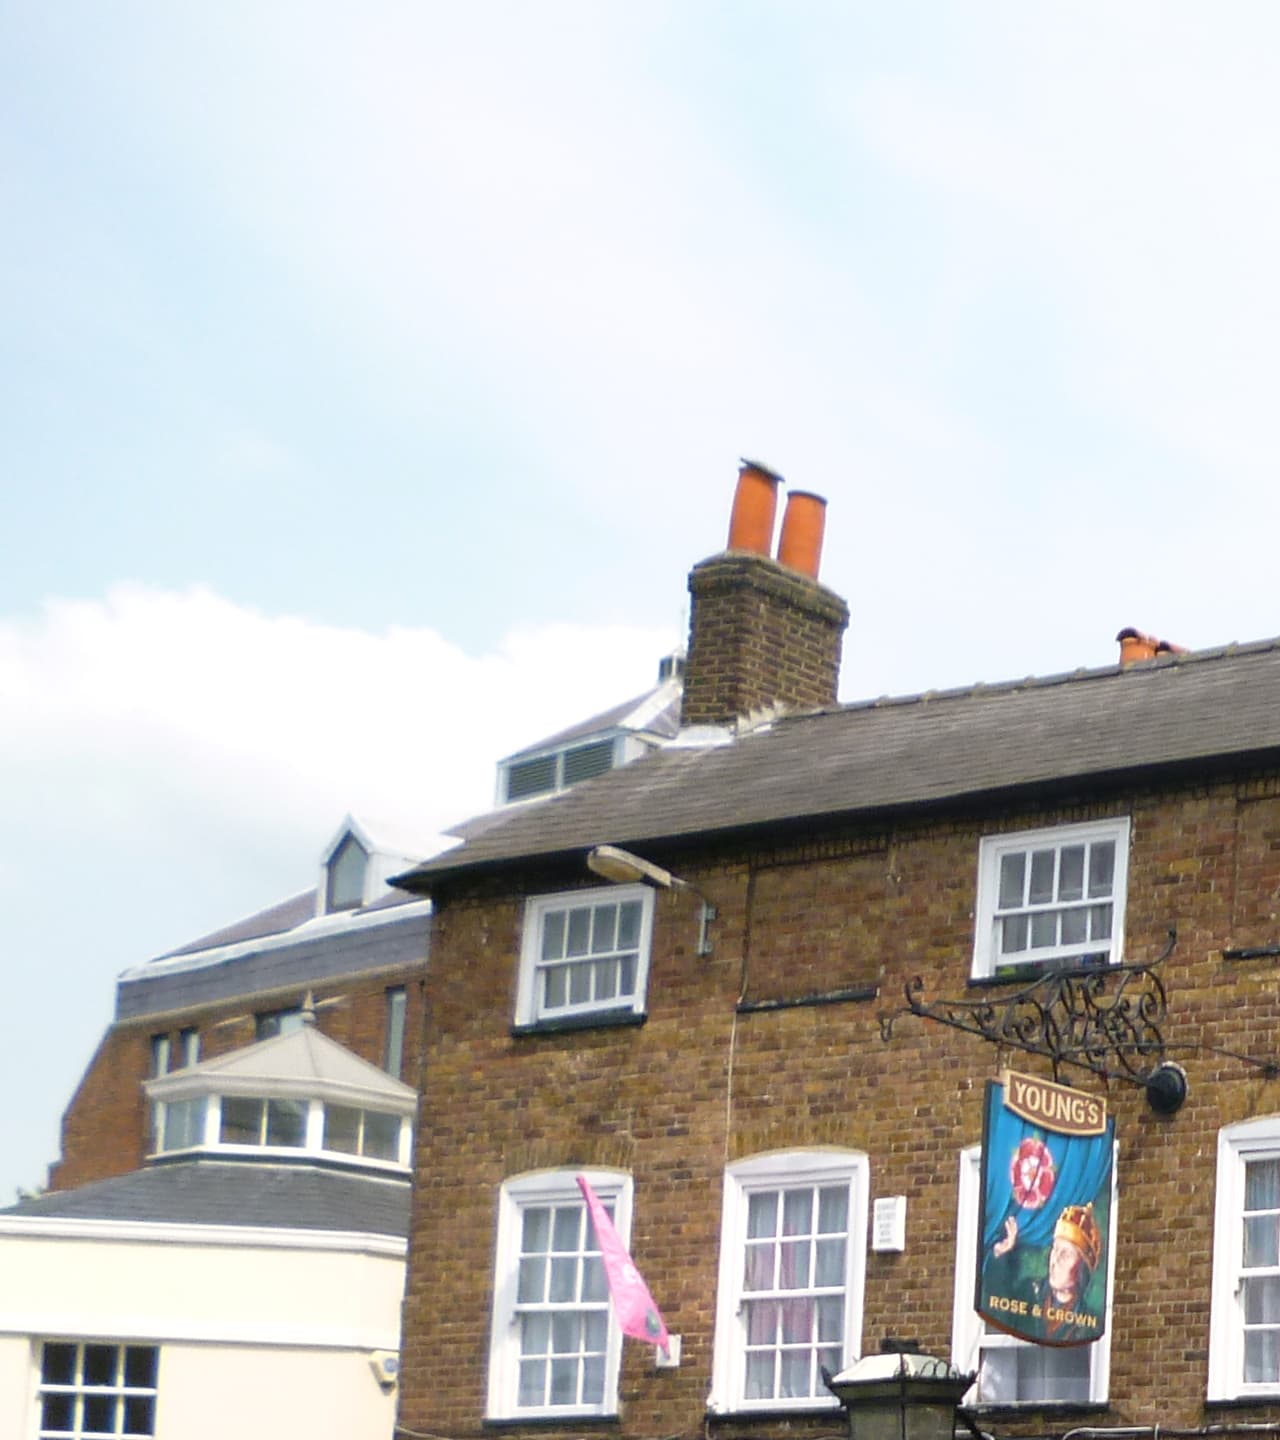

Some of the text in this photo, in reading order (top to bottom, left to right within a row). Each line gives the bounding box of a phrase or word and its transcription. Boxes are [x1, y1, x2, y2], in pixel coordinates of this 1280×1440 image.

[1014, 1080, 1099, 1126] YOUNG'S
[988, 1295, 1098, 1327] ROSE & CROWN
